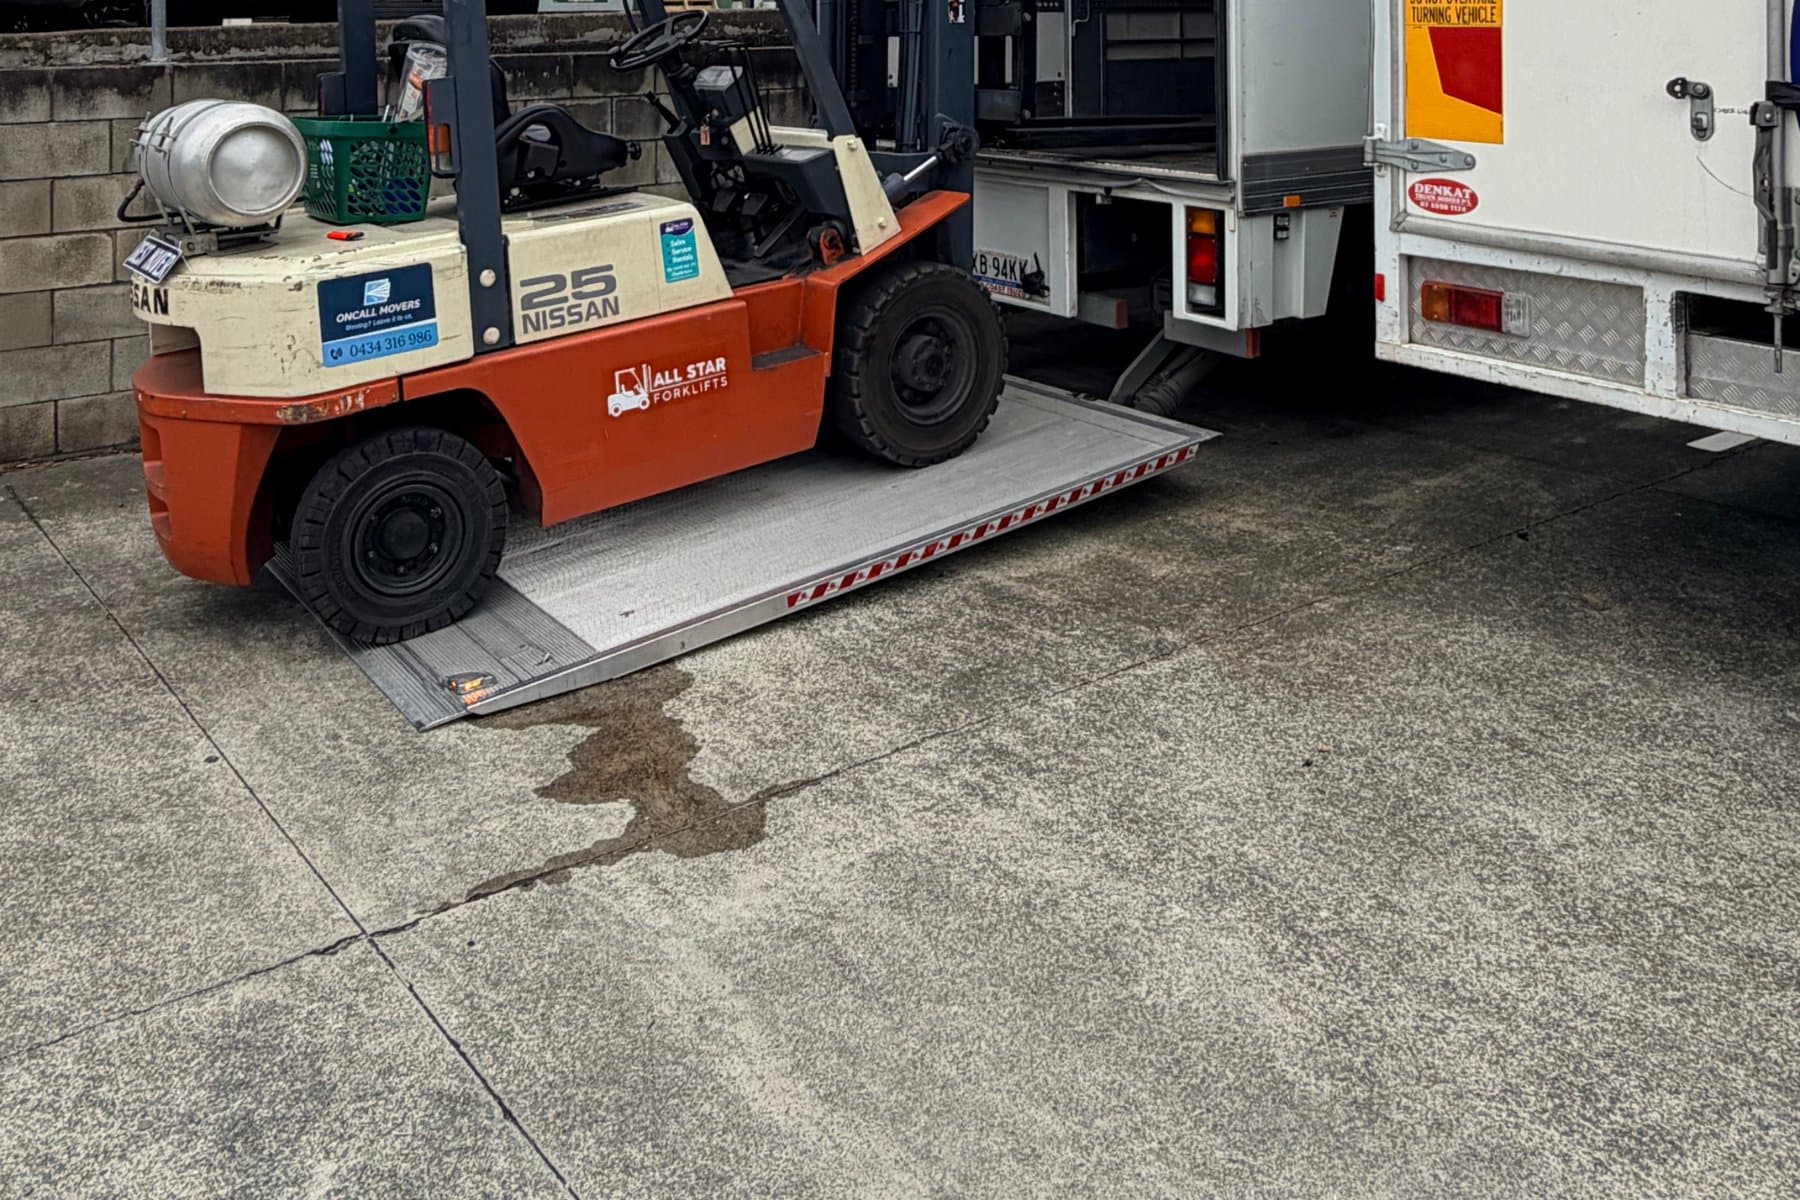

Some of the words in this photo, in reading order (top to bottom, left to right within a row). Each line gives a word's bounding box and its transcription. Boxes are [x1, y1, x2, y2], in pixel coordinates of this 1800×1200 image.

[1411, 6, 1452, 23] TURNING
[1455, 5, 1497, 23] VEHICLE
[1414, 183, 1472, 199] DENKAT
[131, 285, 169, 316] SAN
[520, 264, 617, 311] 25
[336, 307, 377, 323] ONCALL
[379, 299, 421, 316] MOVERS
[522, 296, 620, 335] NISSAN
[349, 341, 382, 358] 0434
[385, 335, 406, 351] 316
[408, 330, 433, 345] 986
[653, 370, 683, 388] ALL
[686, 357, 727, 379] STAR
[654, 376, 728, 404] FORKLIFTS
